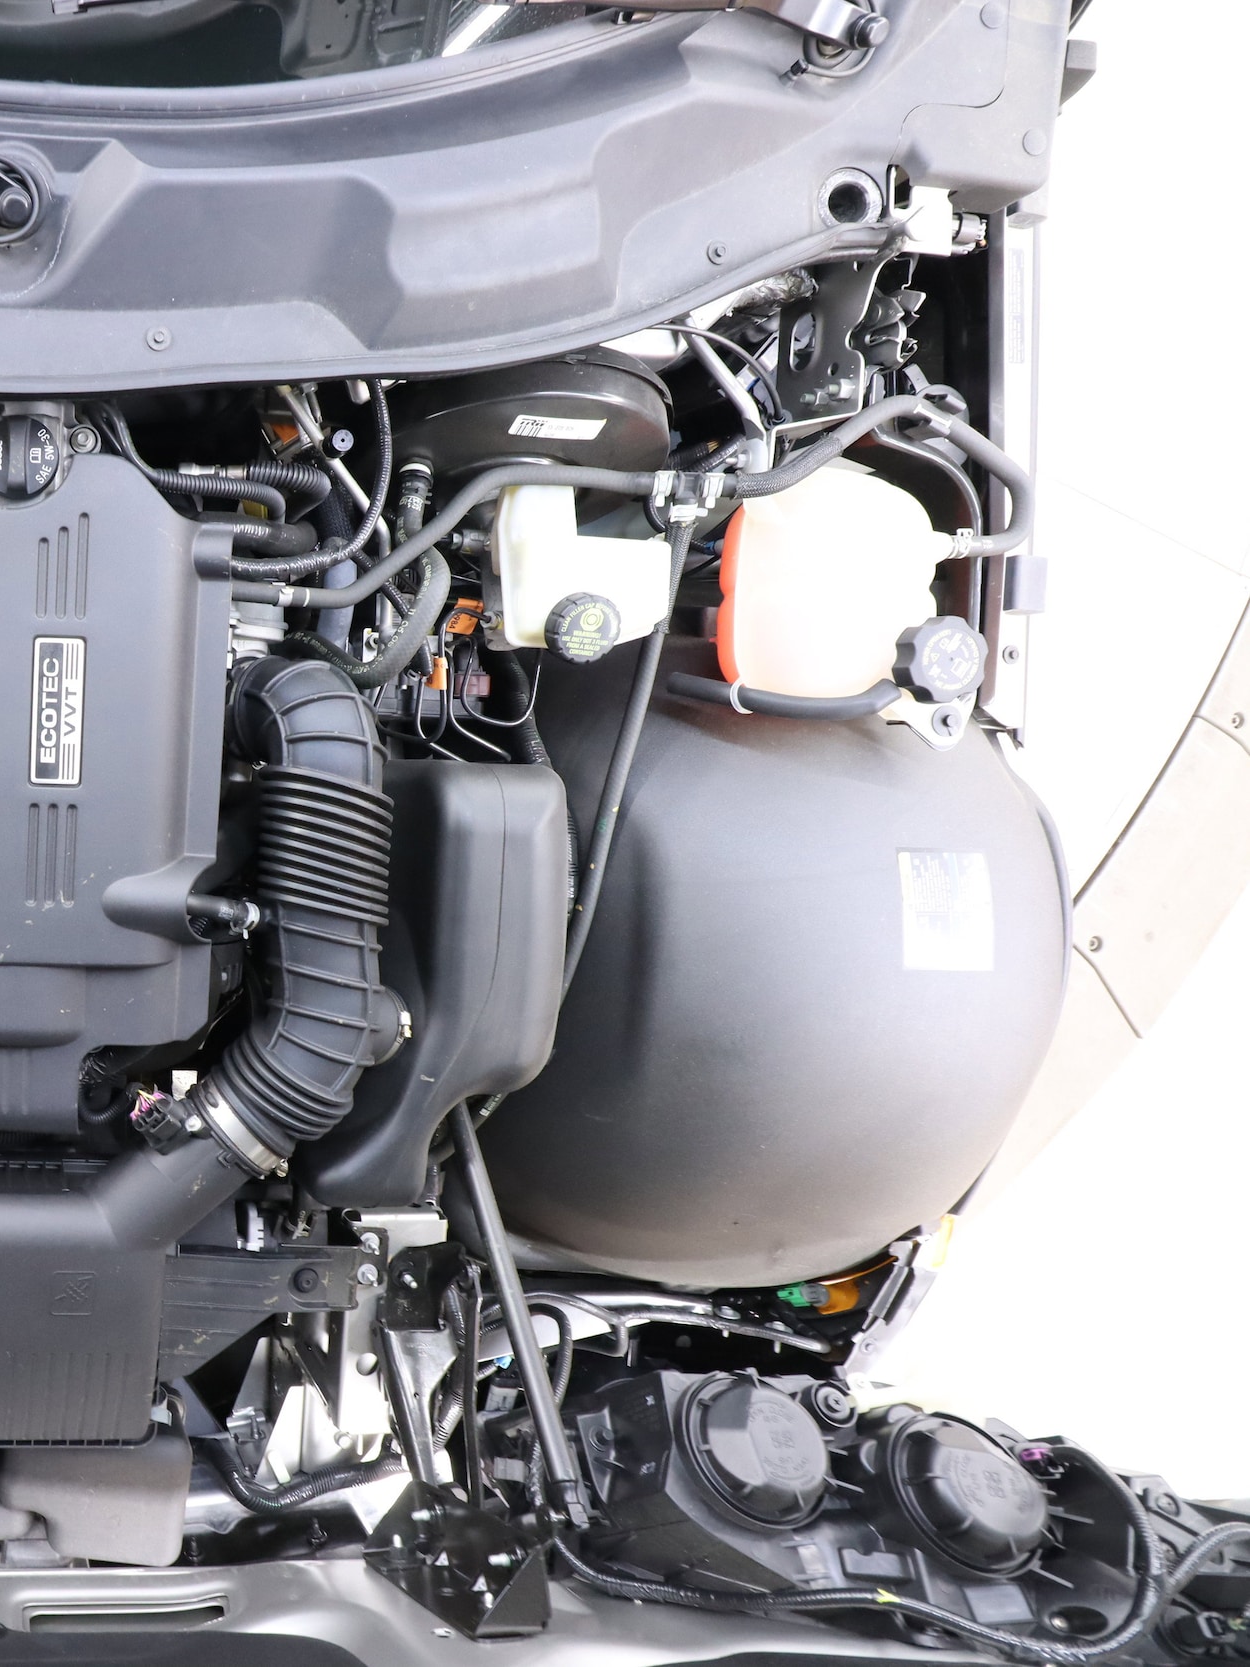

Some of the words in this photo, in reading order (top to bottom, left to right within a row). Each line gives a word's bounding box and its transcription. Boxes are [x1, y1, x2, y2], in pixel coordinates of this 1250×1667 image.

[37, 429, 55, 460] 5W-30
[35, 464, 52, 484] SAE
[561, 616, 572, 632] CLEAN
[570, 605, 585, 618] FILLER
[40, 657, 59, 763] ECOTEC
[63, 686, 76, 737] VVT
